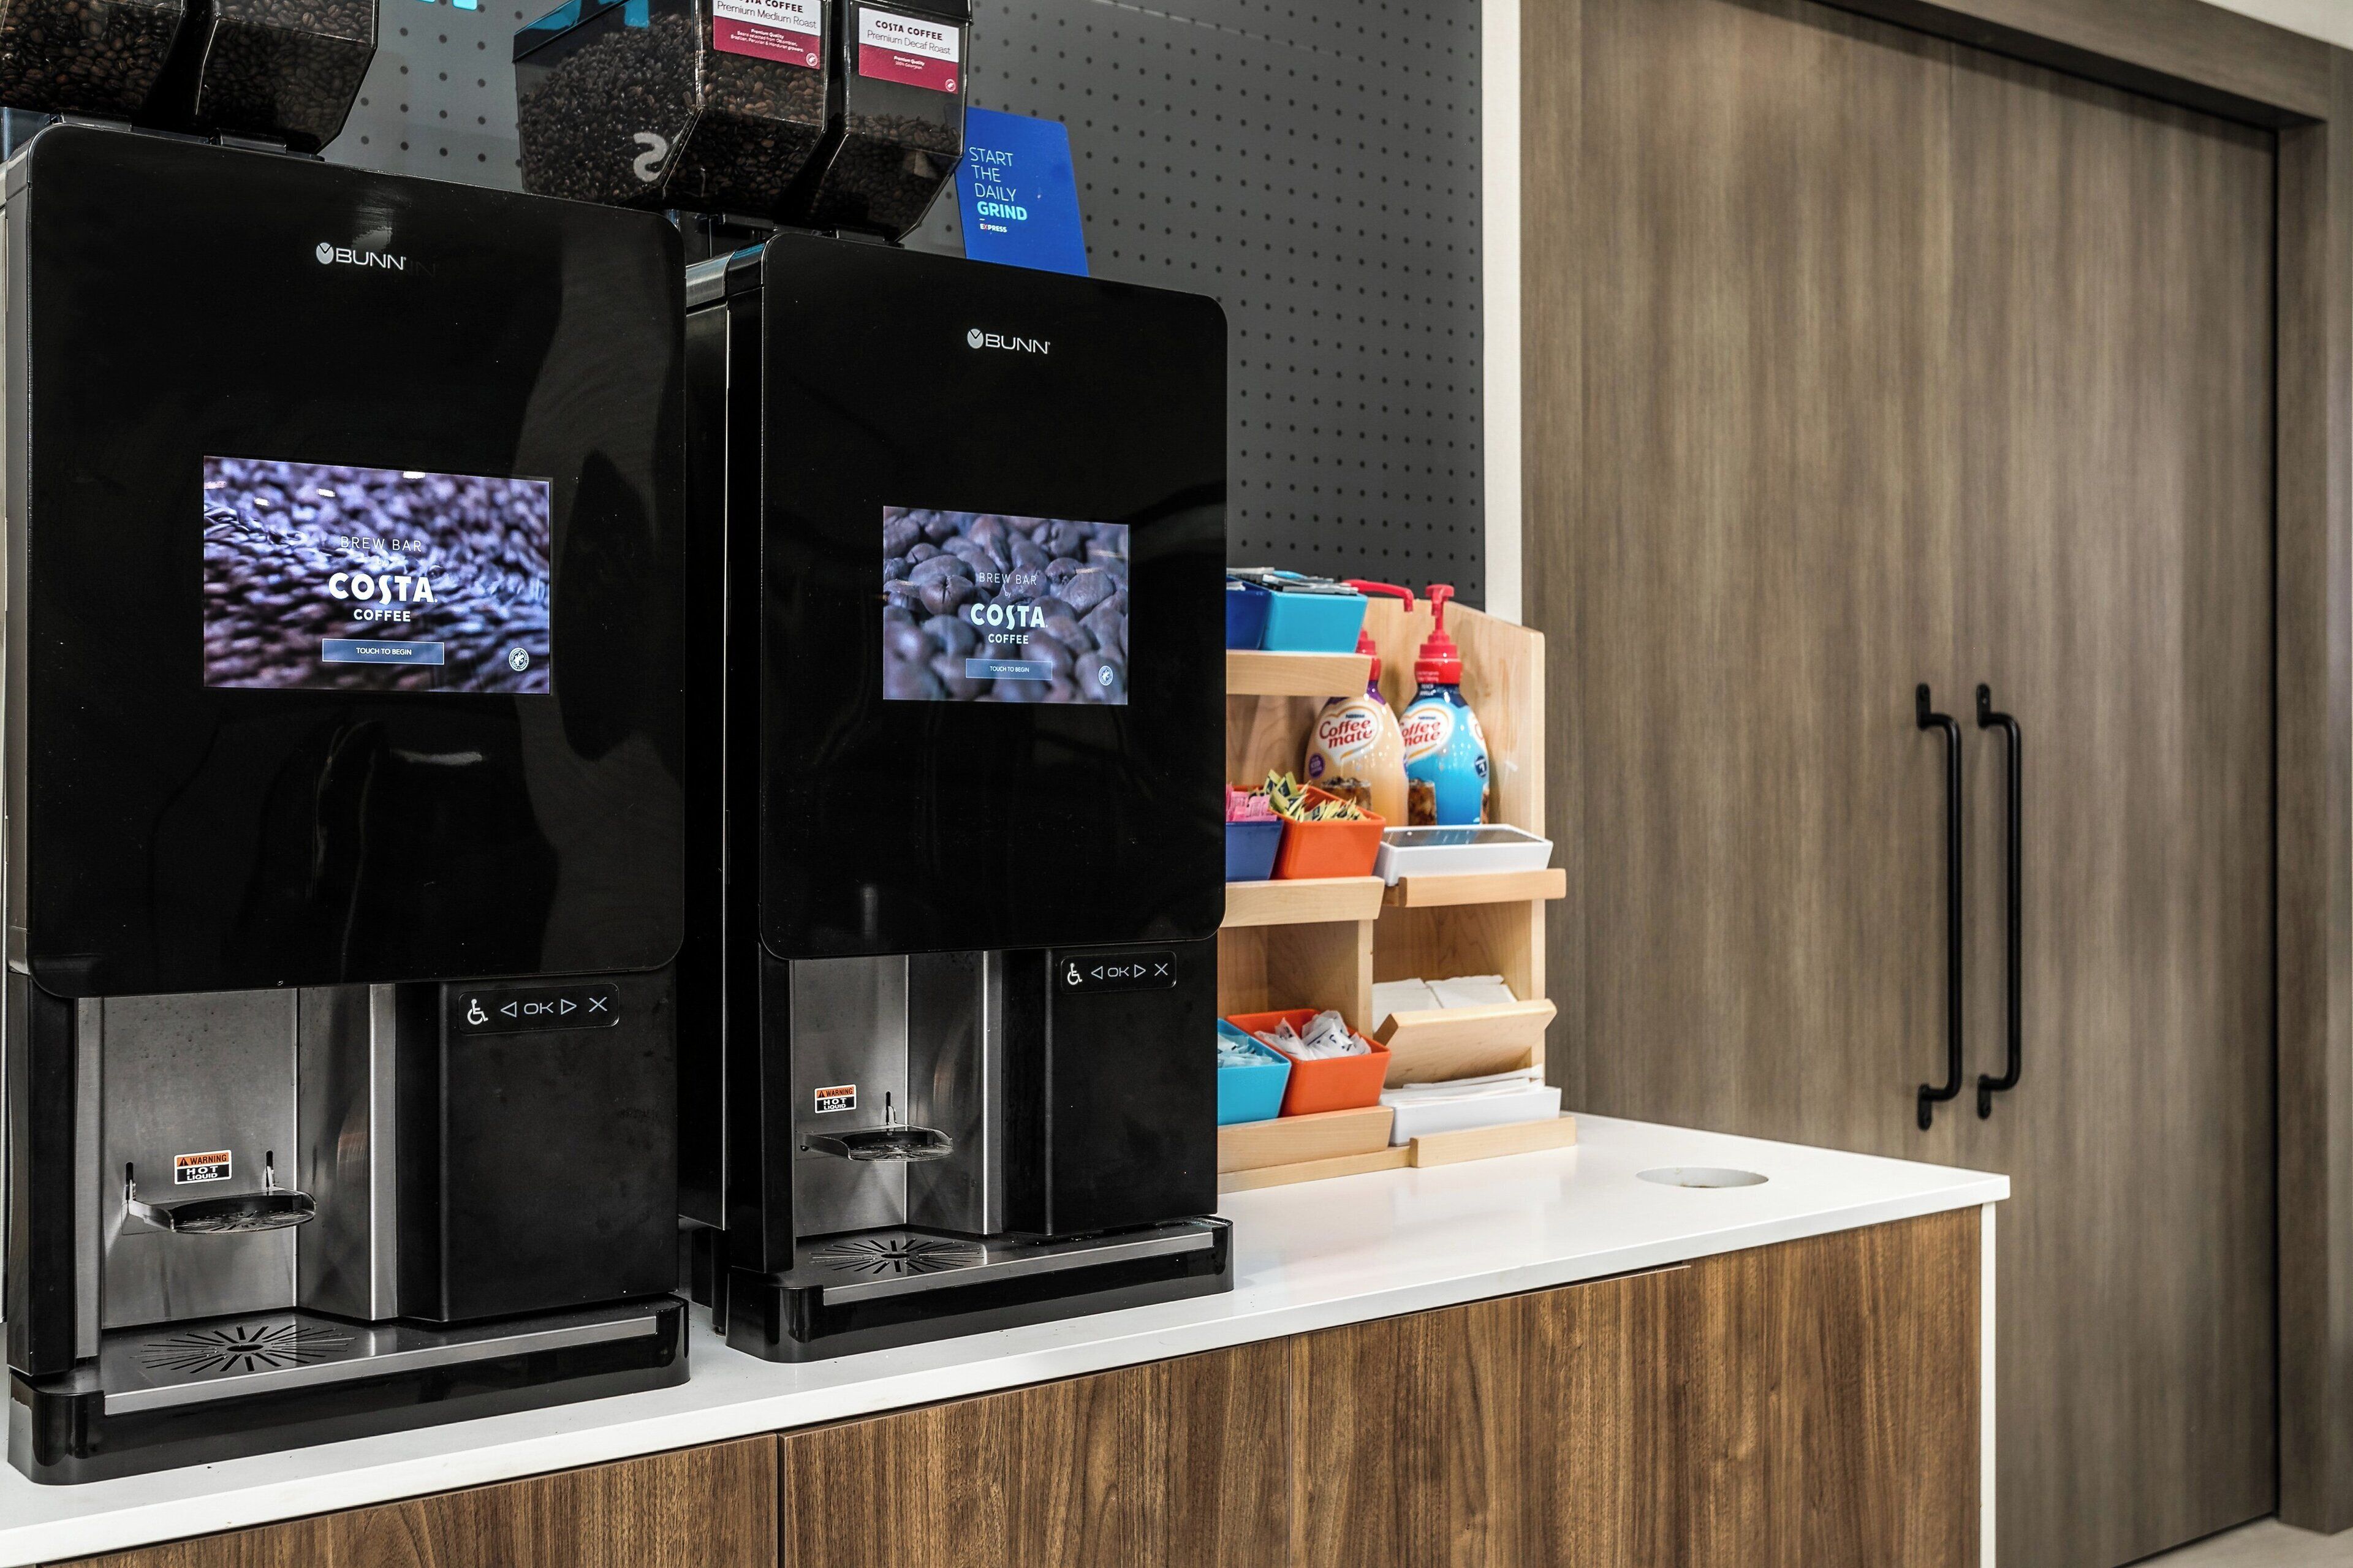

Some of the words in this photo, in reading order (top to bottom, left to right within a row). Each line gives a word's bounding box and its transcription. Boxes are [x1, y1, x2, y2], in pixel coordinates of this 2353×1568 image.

[717, 1, 755, 17] Premium
[757, 9, 791, 23] Medium
[794, 16, 817, 29] Roast
[765, 0, 803, 13] COFFEE
[875, 20, 904, 33] COSTA
[907, 27, 942, 40] COFFEE
[867, 30, 903, 45] Premium
[904, 37, 928, 49] Decaf
[929, 42, 950, 55] Roast
[969, 147, 1014, 167] START
[971, 165, 1001, 183] THE
[974, 183, 1017, 202] DAILY
[977, 201, 1028, 221] GRIND
[980, 223, 1007, 233] EXPRESS
[336, 248, 404, 270] BUNN
[985, 333, 1048, 354] BUNN
[340, 536, 385, 550] BREW
[392, 539, 422, 552] BAR
[979, 572, 1011, 584] BREW
[1015, 574, 1037, 586] BAR
[353, 608, 411, 623] COFFEE
[988, 633, 1029, 645] COFFEE
[1319, 720, 1371, 740] Coffee
[1328, 730, 1373, 749] mate
[1107, 966, 1129, 977] OK
[523, 1002, 554, 1015] OK
[826, 1088, 853, 1097] WARNING
[190, 1154, 227, 1165] WARNING
[186, 1165, 218, 1175] HOT
